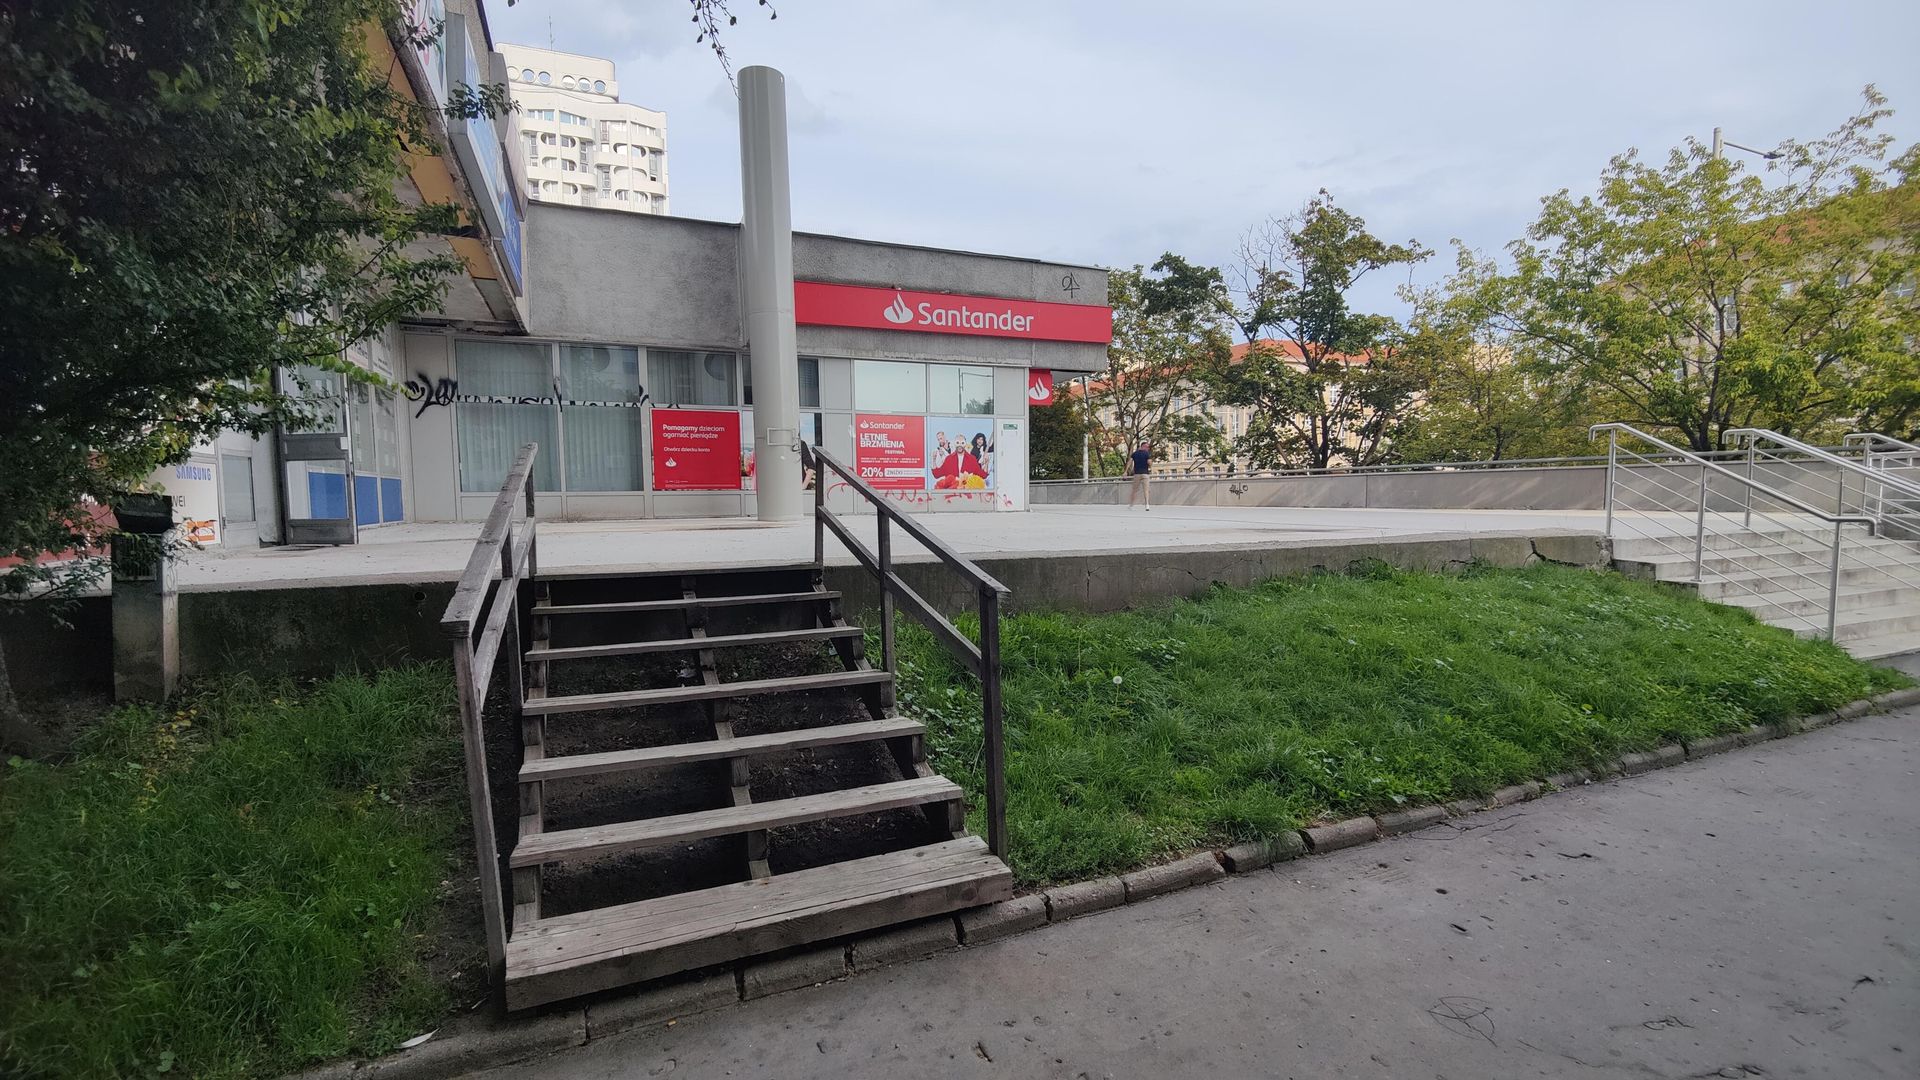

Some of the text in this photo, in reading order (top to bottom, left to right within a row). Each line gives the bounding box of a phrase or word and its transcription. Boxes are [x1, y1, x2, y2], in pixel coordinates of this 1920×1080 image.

[918, 302, 1035, 332] Santander
[662, 424, 698, 432] Pomagamy
[870, 421, 905, 430] Santander
[860, 433, 888, 441] LETNIE
[860, 440, 905, 448] BRZMIENIA
[176, 465, 212, 481] SAMSUNG
[861, 467, 883, 477] 20%
[172, 495, 186, 507] WEI
